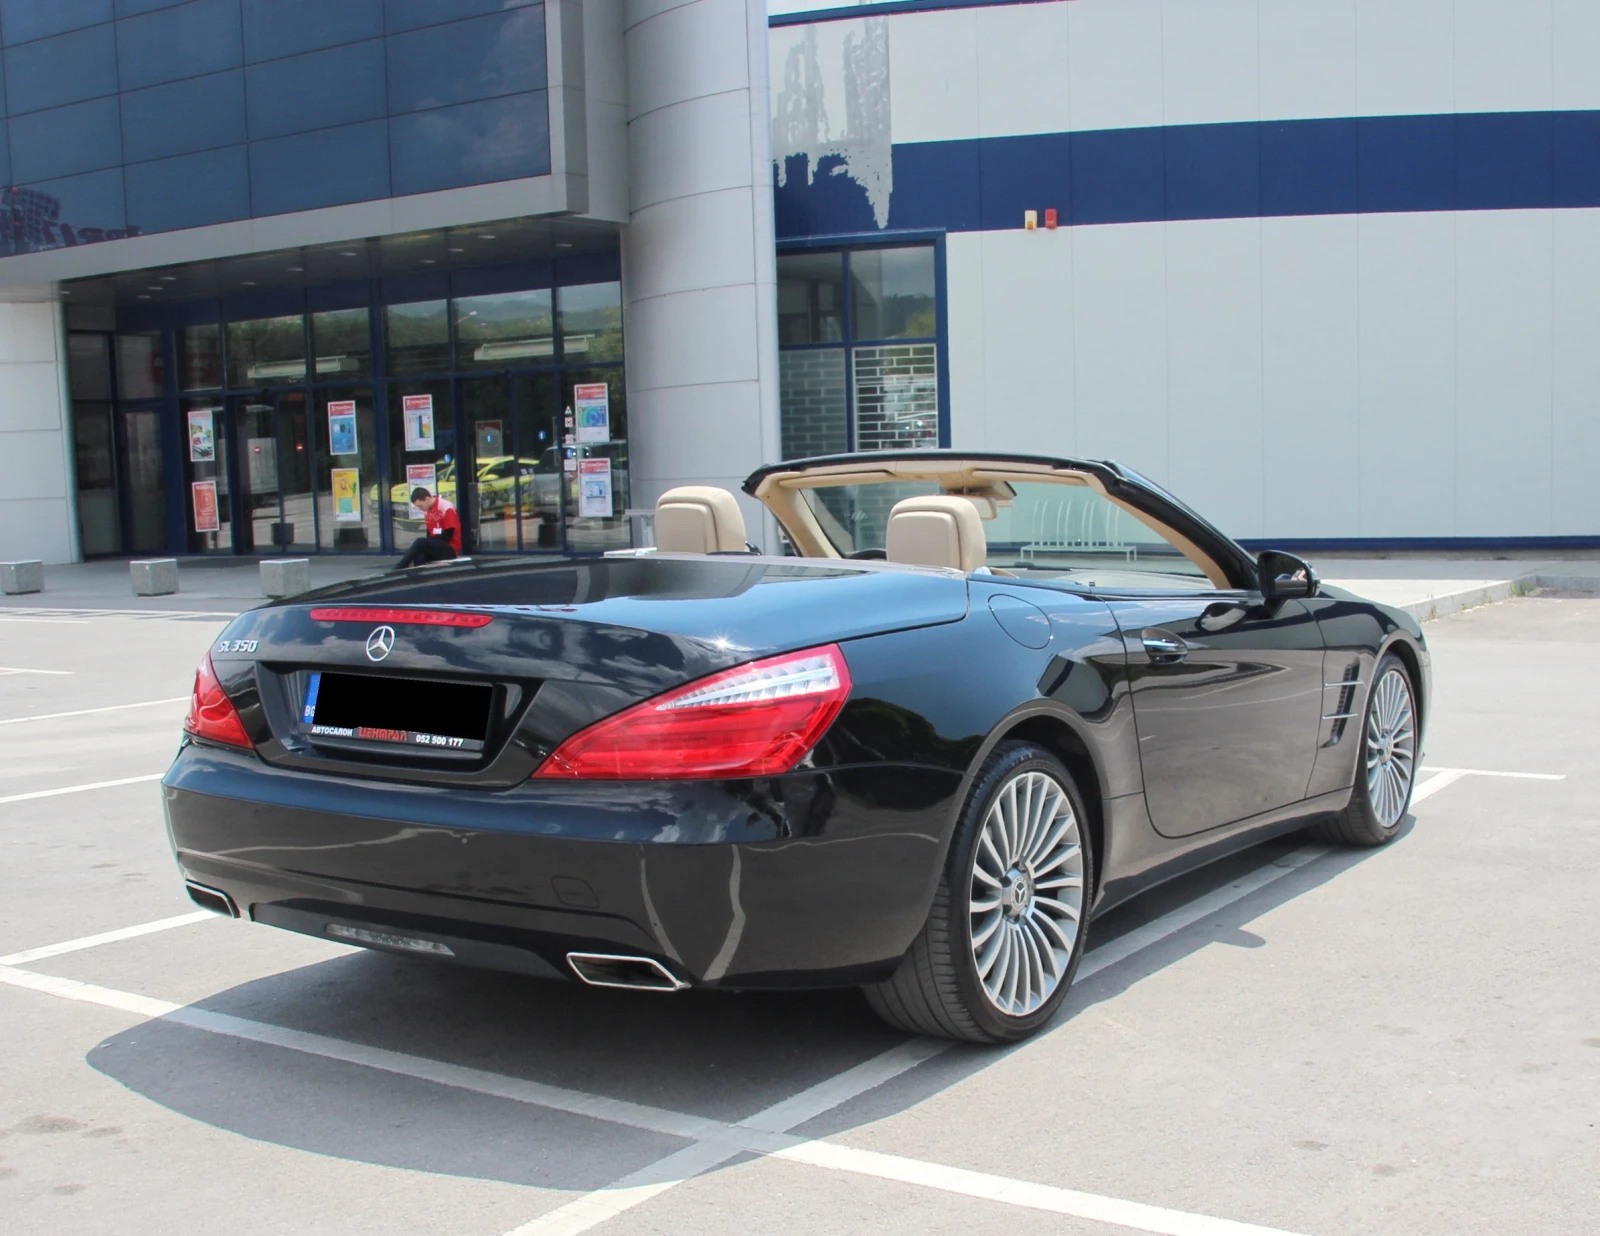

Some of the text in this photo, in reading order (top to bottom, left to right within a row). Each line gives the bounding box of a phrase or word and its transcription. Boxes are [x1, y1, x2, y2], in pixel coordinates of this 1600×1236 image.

[312, 726, 353, 737] АВТОСАЛОН
[416, 734, 430, 744] 052
[431, 735, 447, 746] 500
[448, 737, 464, 747] 177
